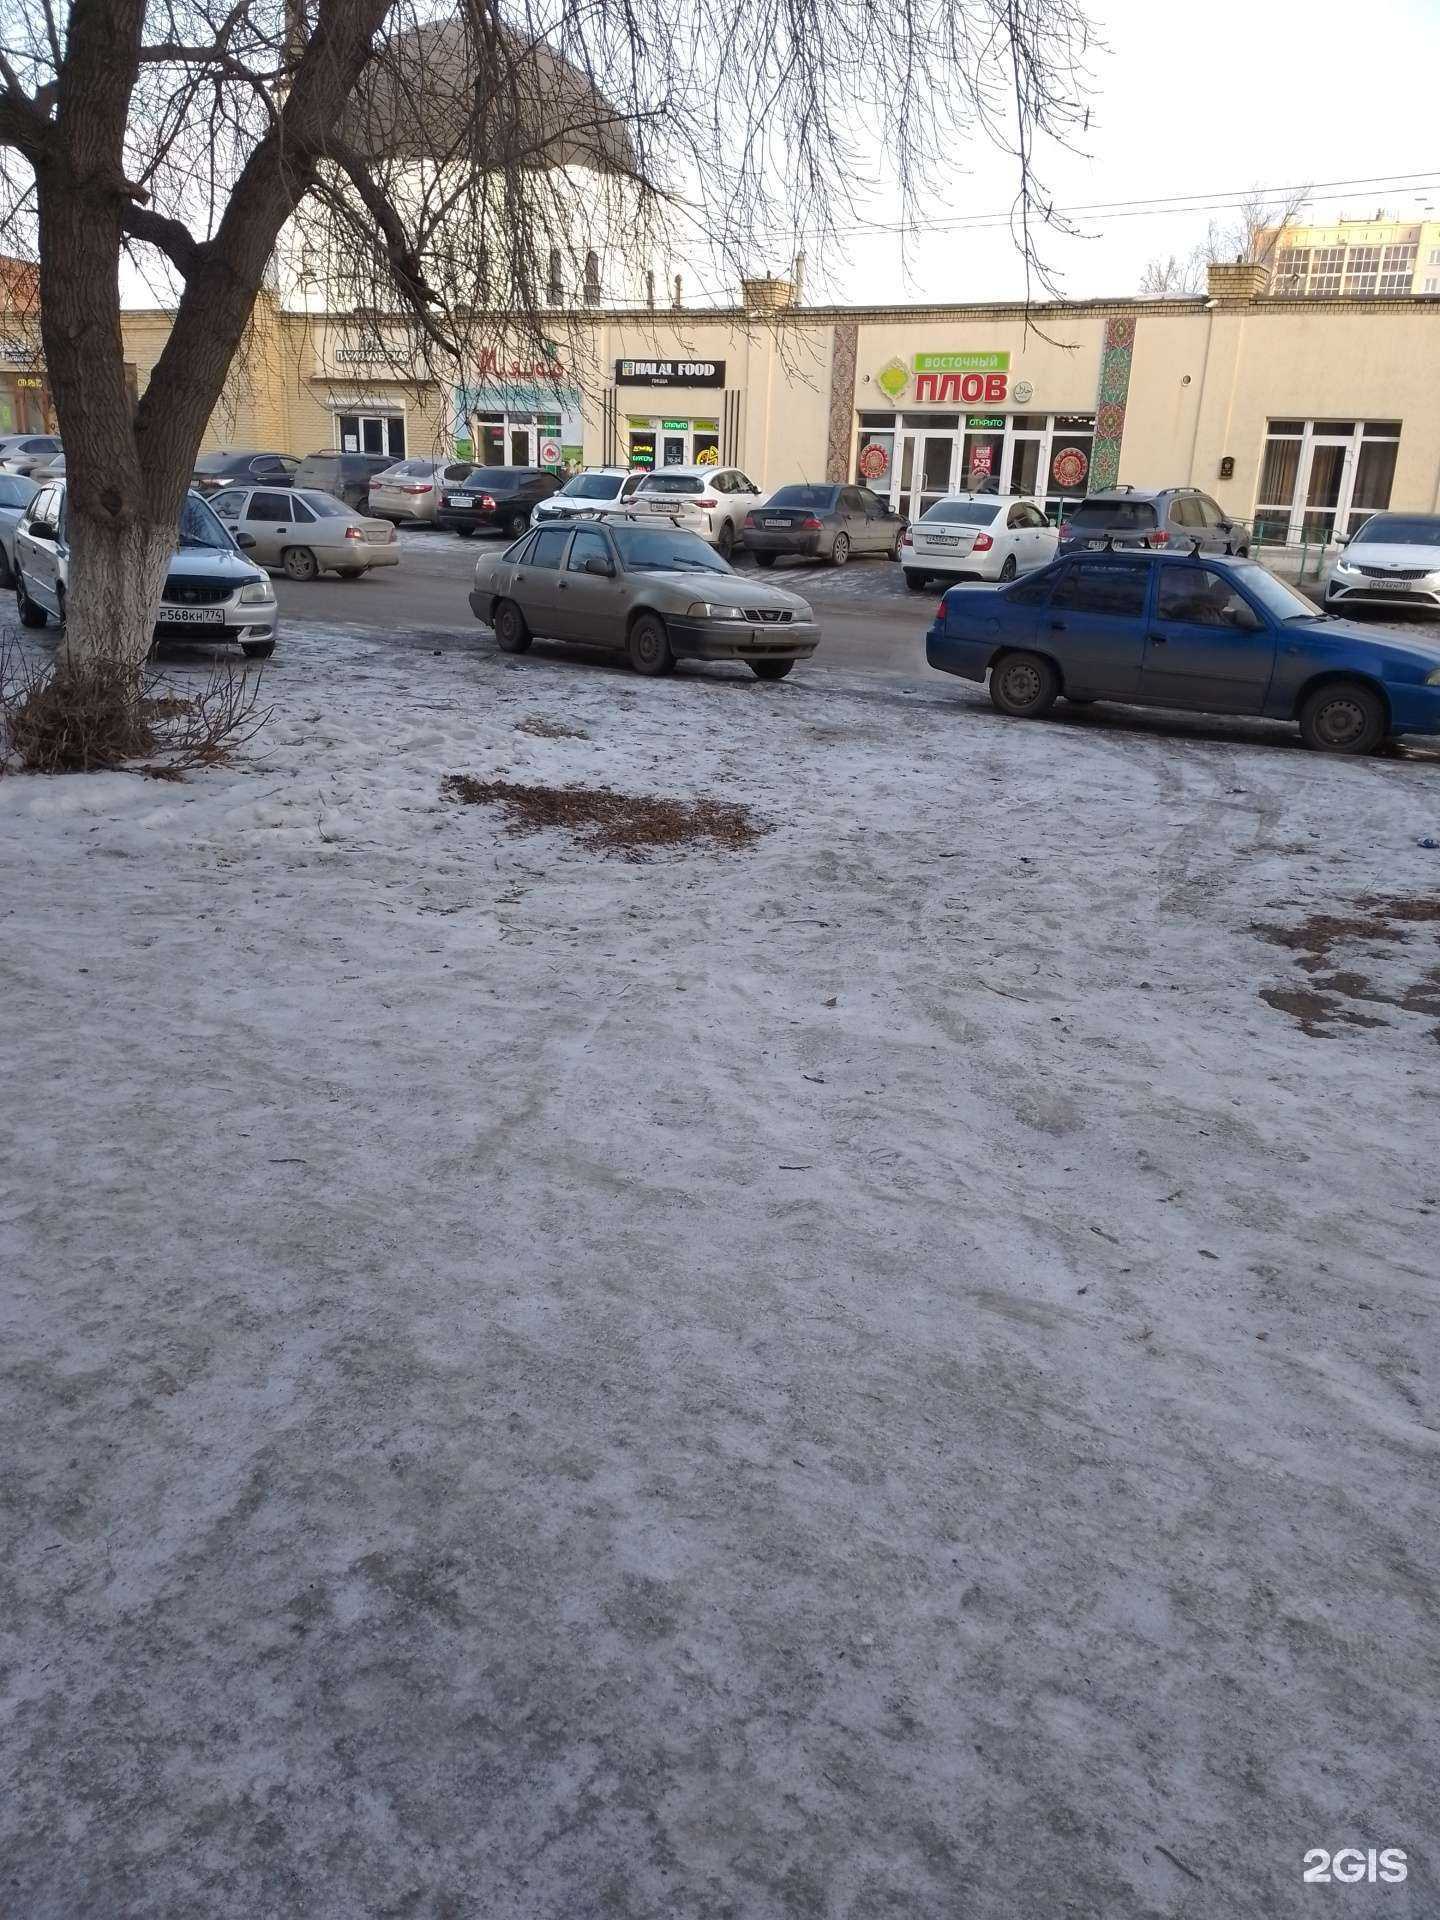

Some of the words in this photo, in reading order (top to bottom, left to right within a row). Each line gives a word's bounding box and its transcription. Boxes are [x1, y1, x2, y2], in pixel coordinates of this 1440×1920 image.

[924, 354, 999, 367] ВОСТОЧНЫЙ
[635, 362, 675, 376] HALAL
[677, 363, 716, 376] FOOD
[914, 373, 1009, 403] ПЛОВ
[969, 418, 1004, 427] ОТКРЫТО
[974, 458, 991, 467] 9-23
[160, 610, 203, 621] Р568КН
[205, 610, 221, 618] 774
